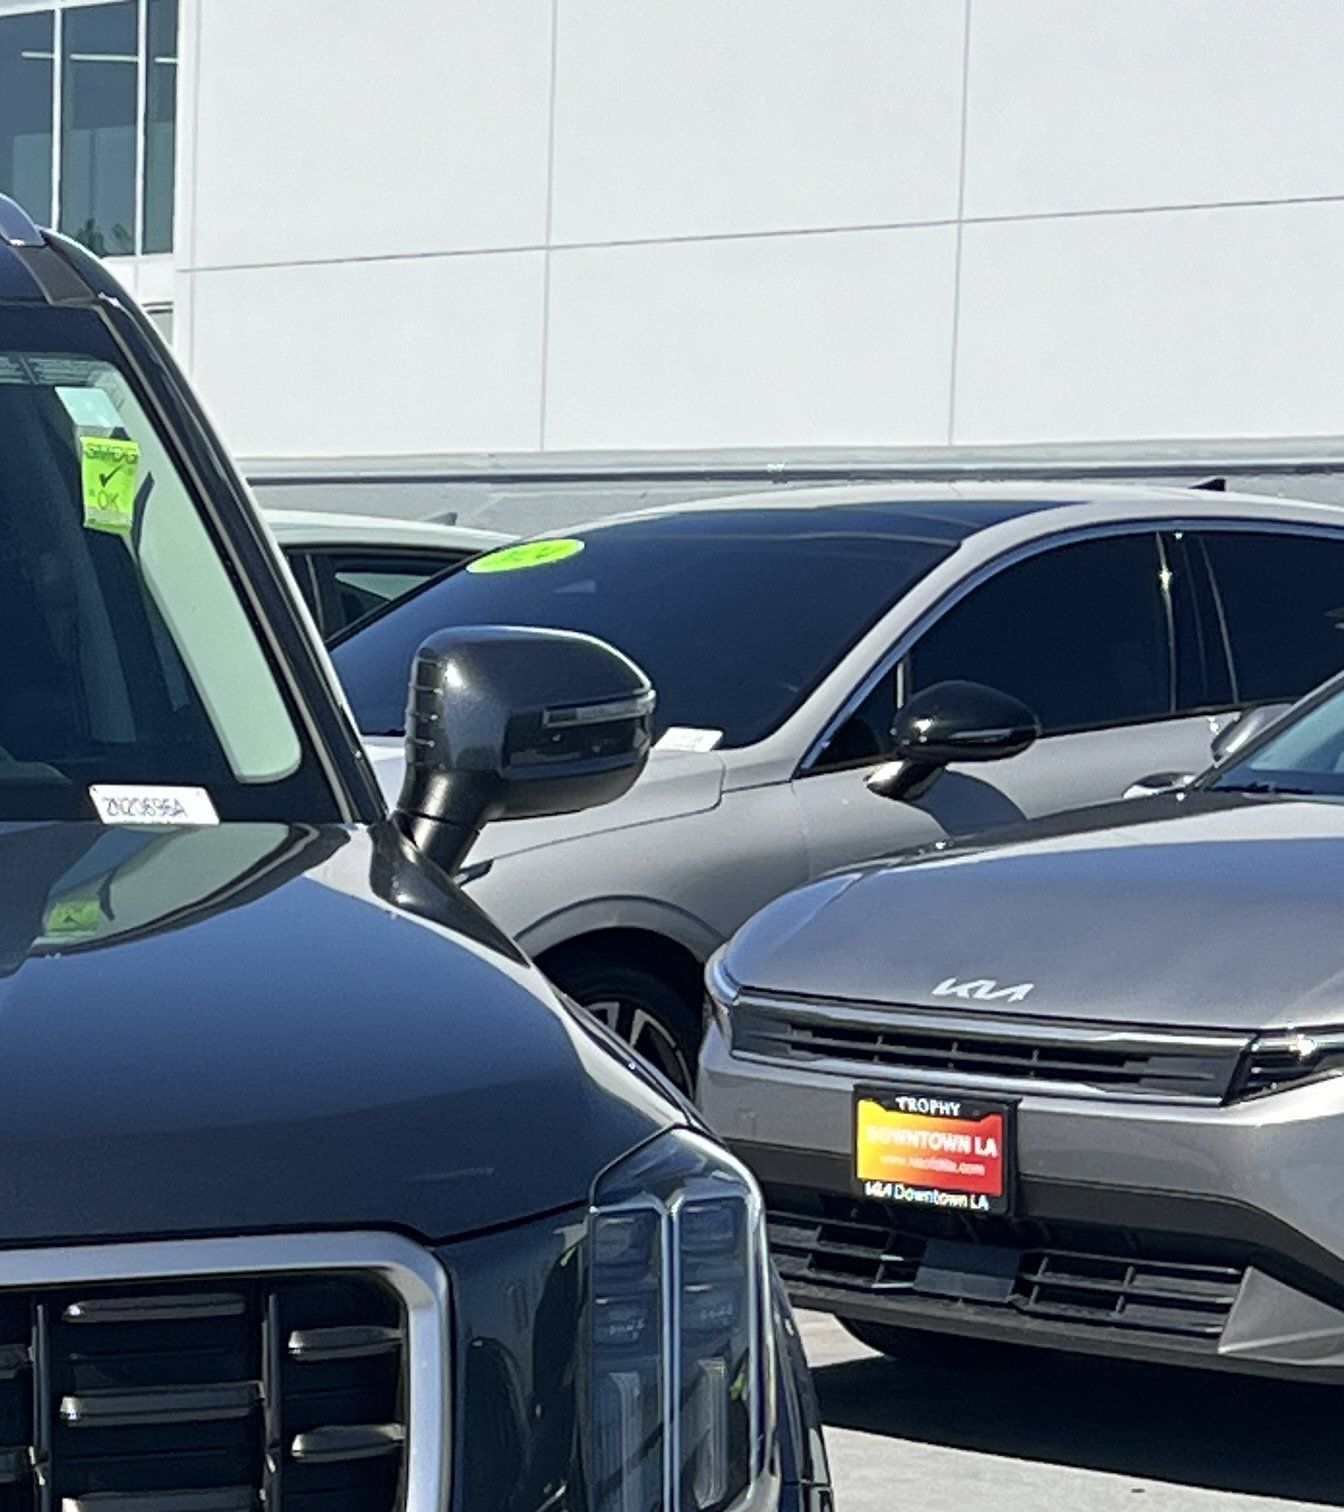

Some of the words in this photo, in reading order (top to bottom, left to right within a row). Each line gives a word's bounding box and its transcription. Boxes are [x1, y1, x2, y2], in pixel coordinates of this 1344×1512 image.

[932, 977, 1034, 1003] KIA
[895, 1096, 961, 1117] TROPHY
[868, 1127, 972, 1153] DOWNTOWN
[974, 1136, 999, 1158] LA
[894, 1183, 968, 1208] Downtown
[969, 1194, 990, 1211] LA
